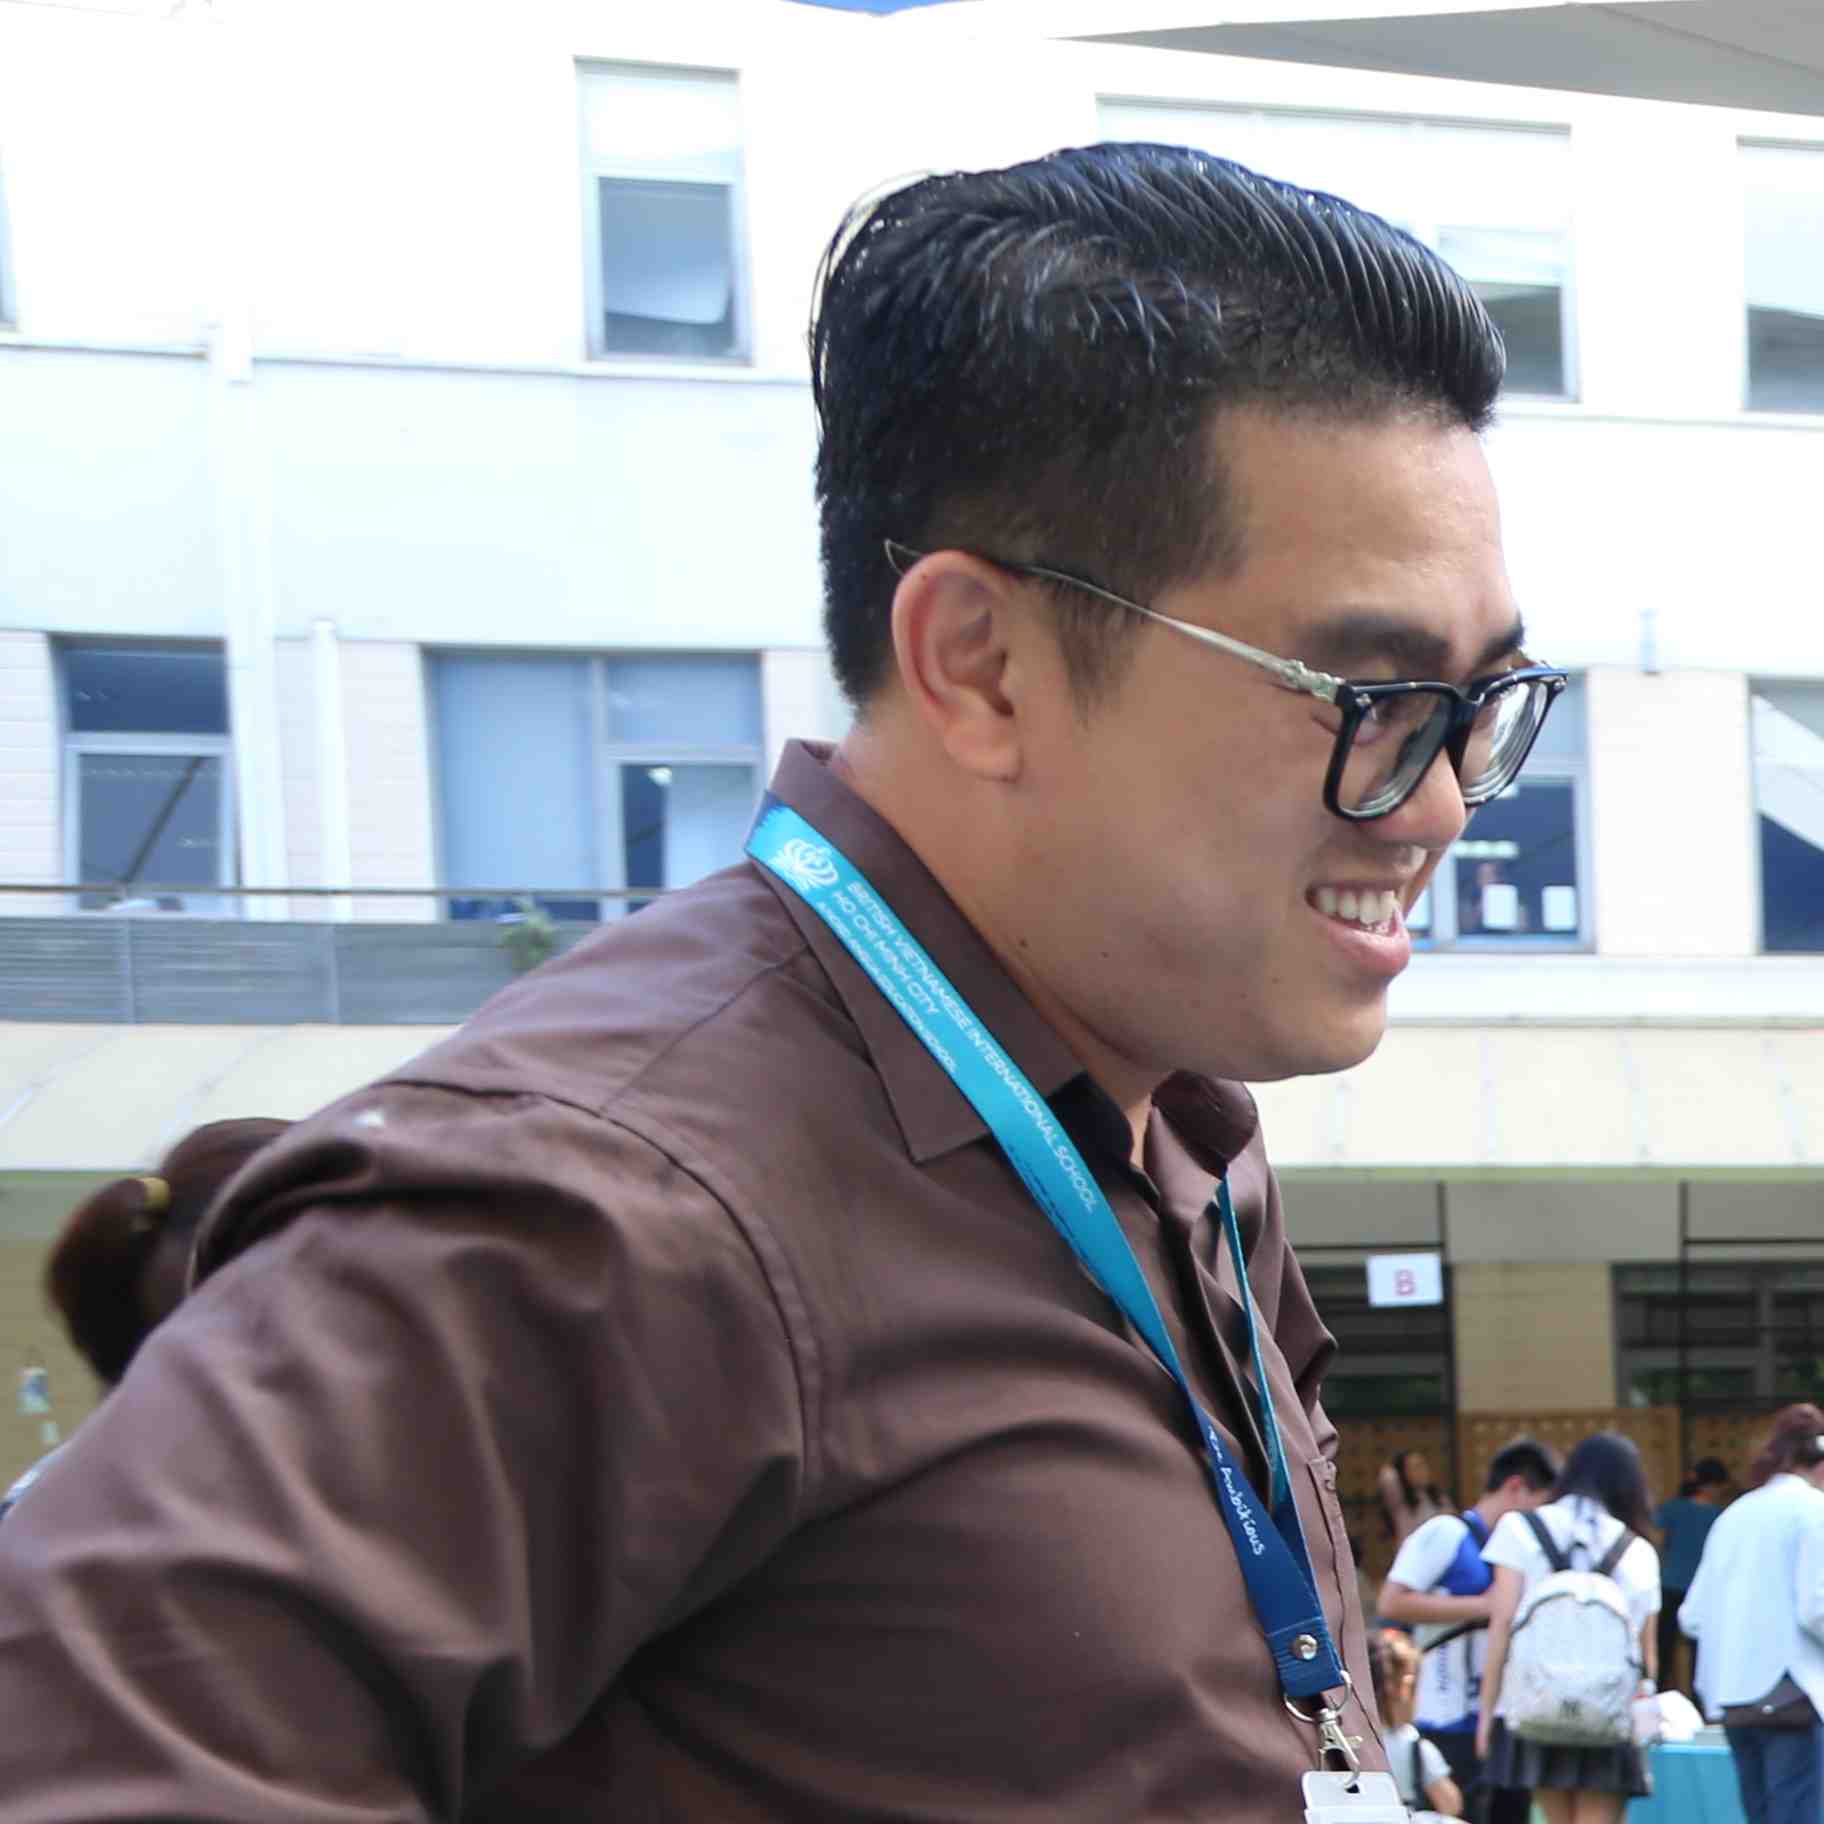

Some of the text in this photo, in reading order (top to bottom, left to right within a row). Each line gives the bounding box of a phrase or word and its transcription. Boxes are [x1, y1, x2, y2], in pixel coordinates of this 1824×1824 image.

[832, 889, 939, 1017] HO CHI MINH CITY
[848, 880, 1097, 1214] BRITISH VIETNAMESE INTERNATIONAL SCHOOL
[1393, 1268, 1417, 1298] B
